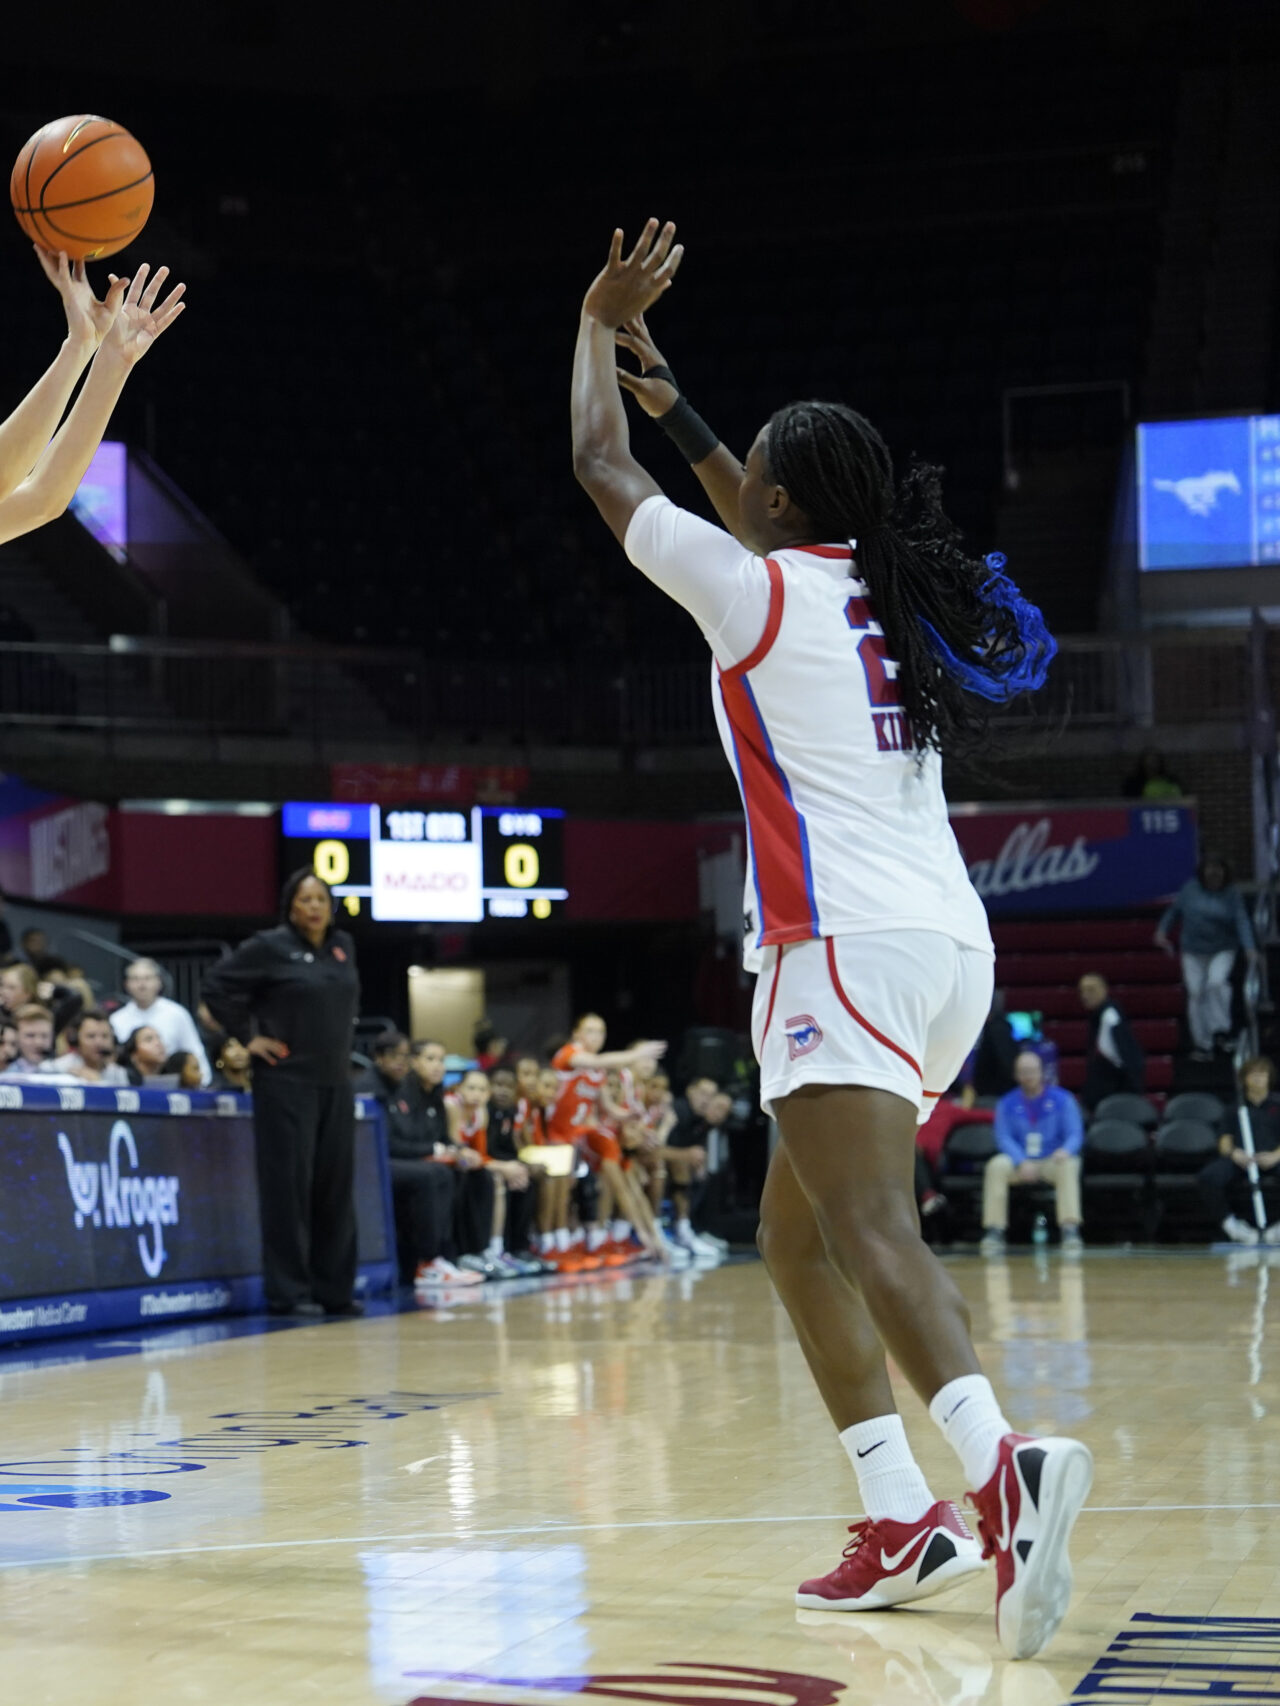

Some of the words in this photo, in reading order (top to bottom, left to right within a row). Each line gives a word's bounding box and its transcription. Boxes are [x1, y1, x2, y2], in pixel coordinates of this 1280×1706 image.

[1141, 810, 1179, 834] 115
[313, 839, 350, 885] 0
[504, 843, 540, 888] 0
[970, 817, 1099, 897] allas
[101, 1120, 179, 1278] Kroger
[209, 1391, 501, 1420] Bank
